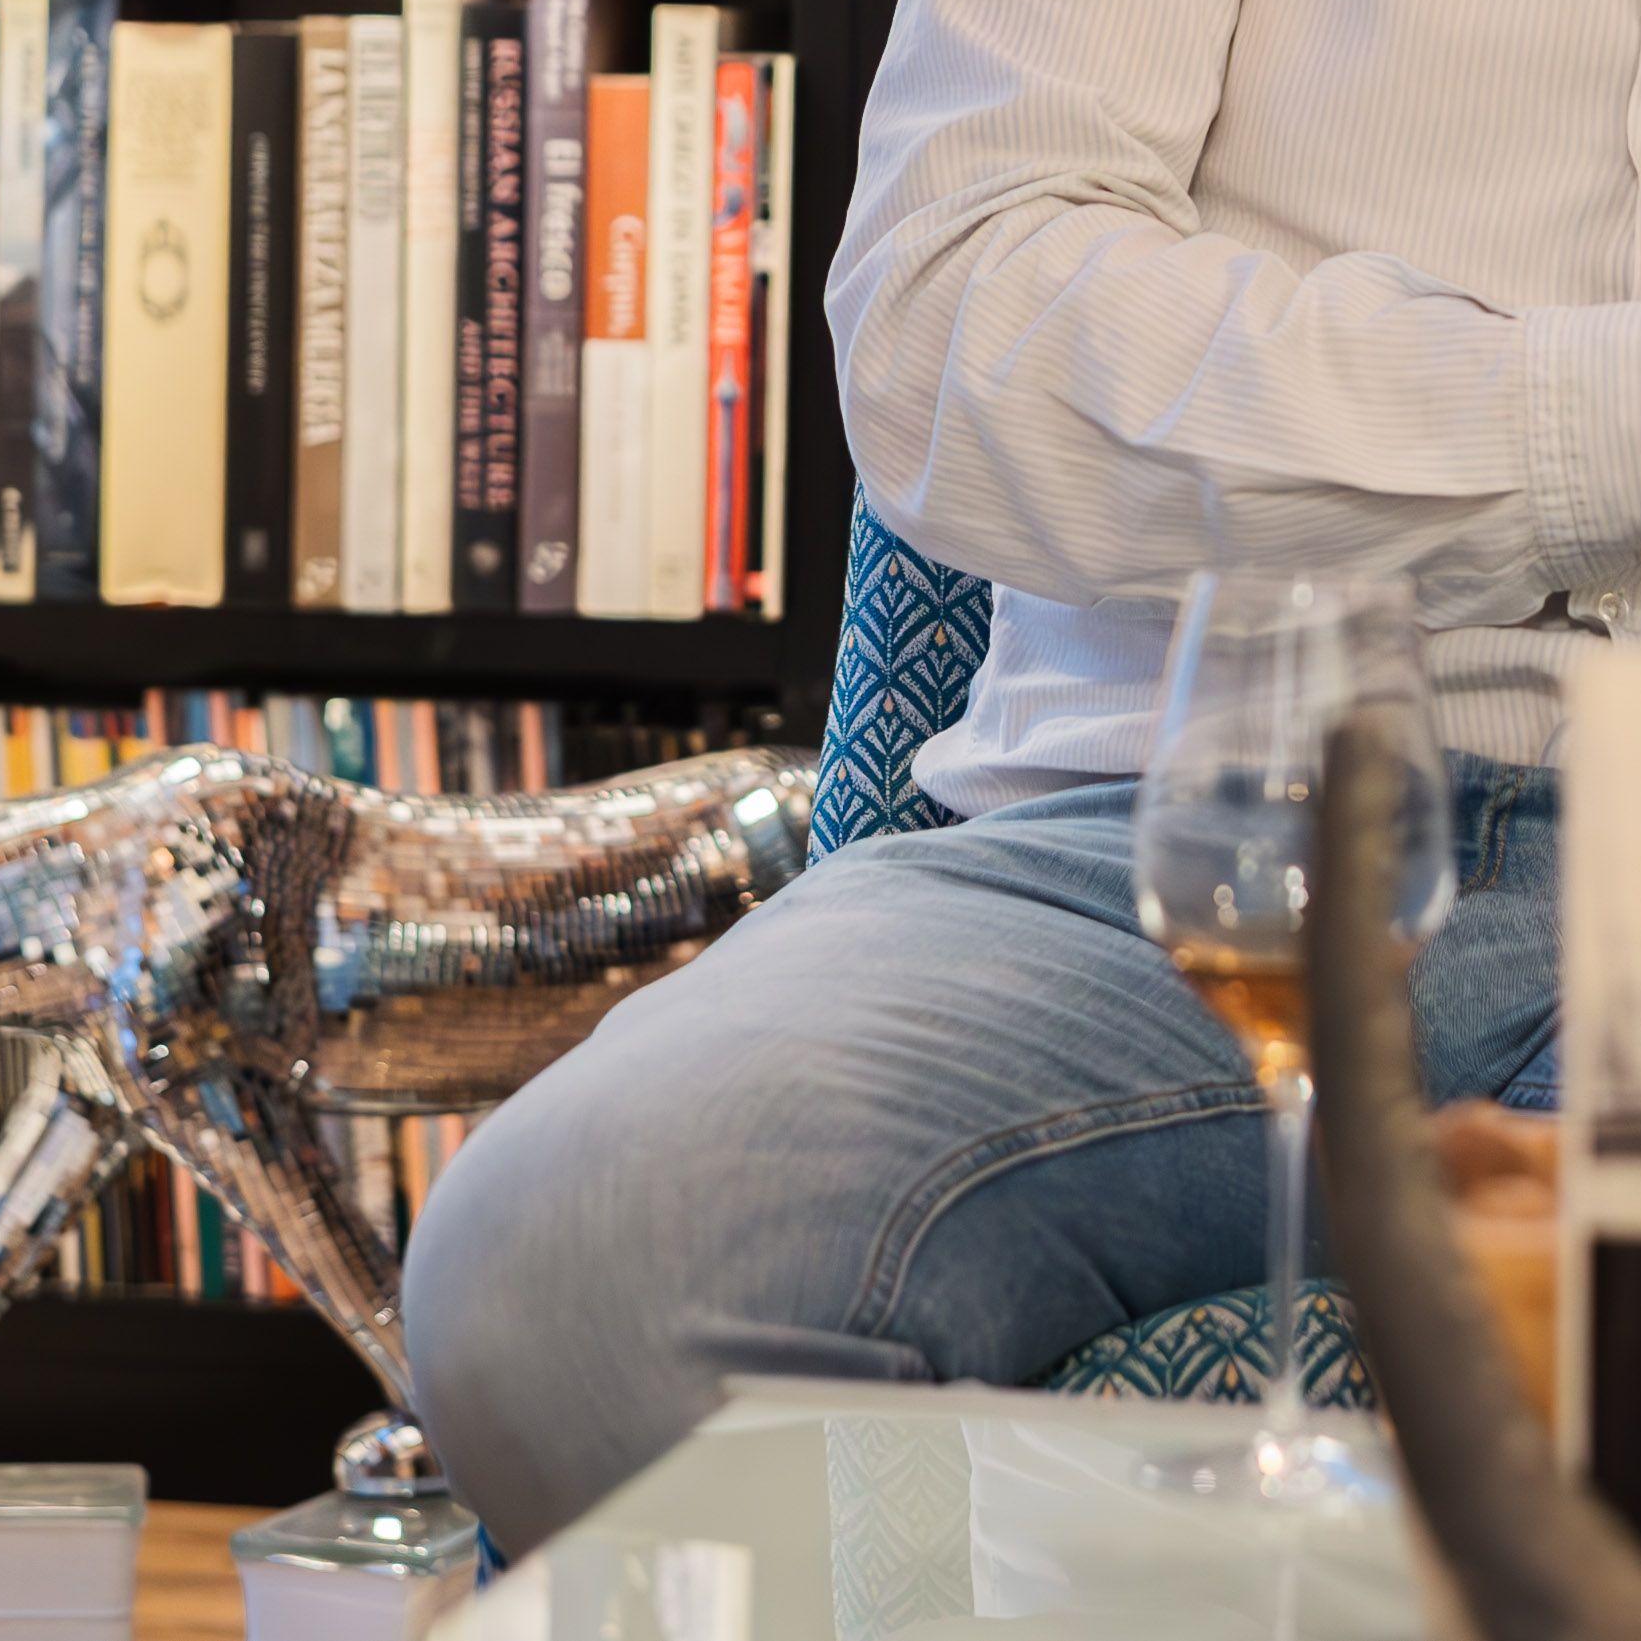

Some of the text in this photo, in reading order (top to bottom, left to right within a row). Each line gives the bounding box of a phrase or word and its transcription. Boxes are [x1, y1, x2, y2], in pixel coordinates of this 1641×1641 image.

[485, 38, 521, 513] RUSSIAN ARCHITECTURE
[538, 137, 583, 301] El fresco
[602, 213, 646, 336] Corpus
